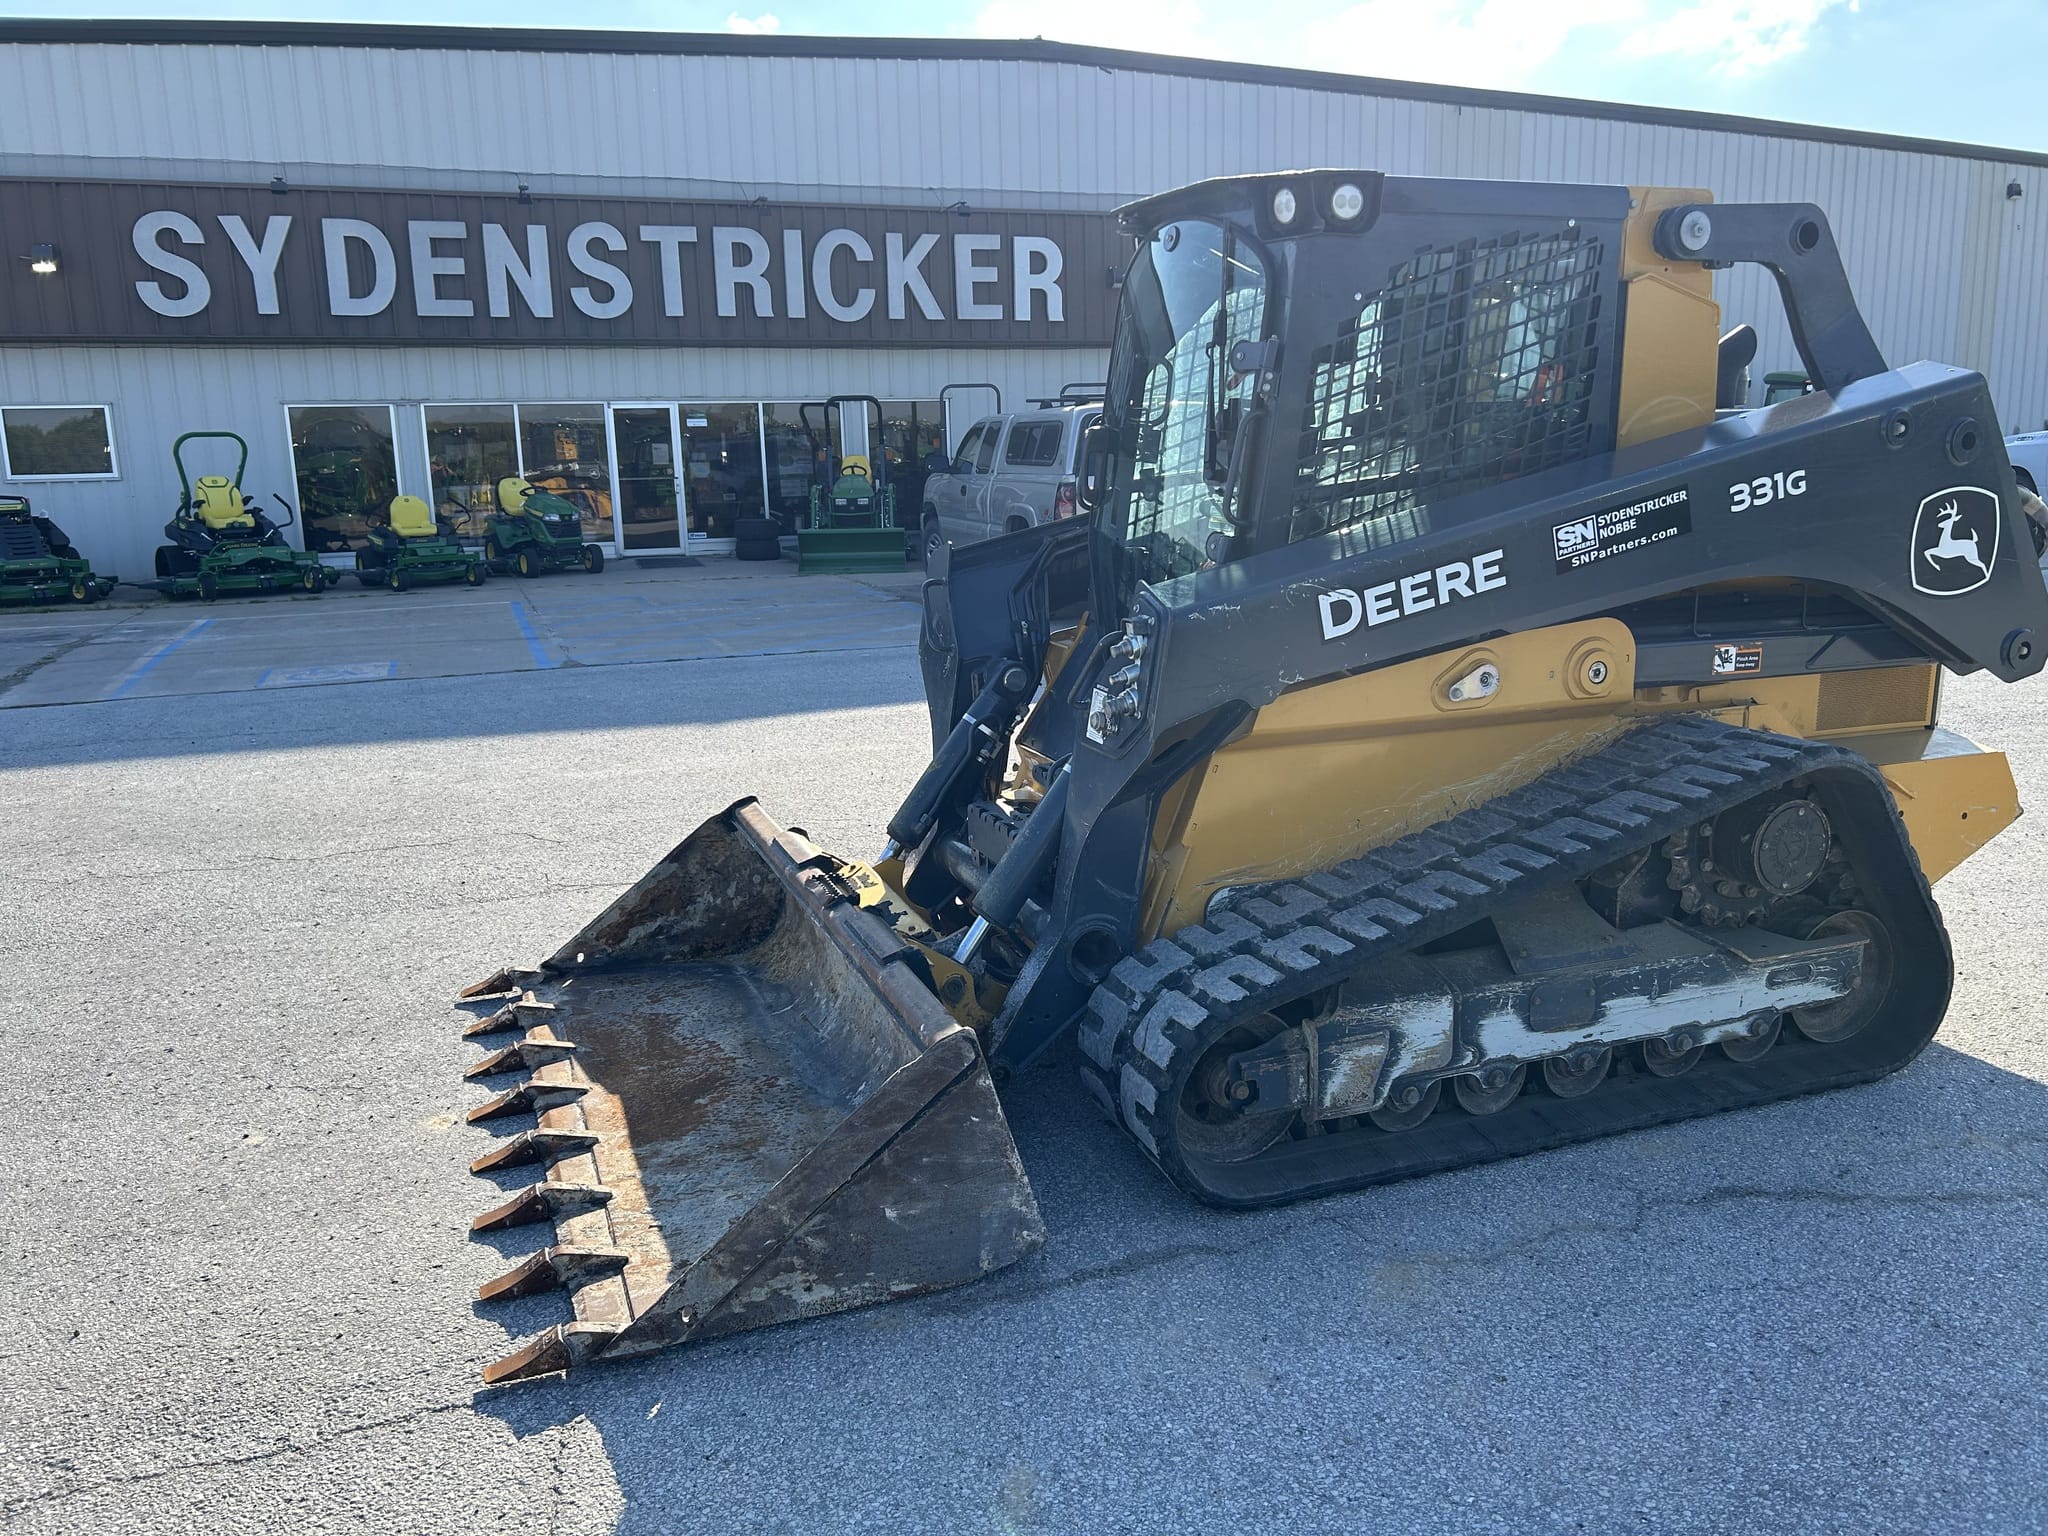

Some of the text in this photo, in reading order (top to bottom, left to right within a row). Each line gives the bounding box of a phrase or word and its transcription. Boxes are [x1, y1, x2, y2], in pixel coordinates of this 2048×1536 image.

[131, 209, 1065, 323] SYDENSTRICKER
[1597, 490, 1688, 527] SYDENSTRICKER
[1729, 469, 1807, 513] 331G
[1557, 519, 1595, 548] SN
[1558, 539, 1597, 556] PARTNERS
[1571, 526, 1679, 568] SNPartners.com
[1599, 518, 1638, 540] NOBBE
[1318, 548, 1507, 641] DEERE
